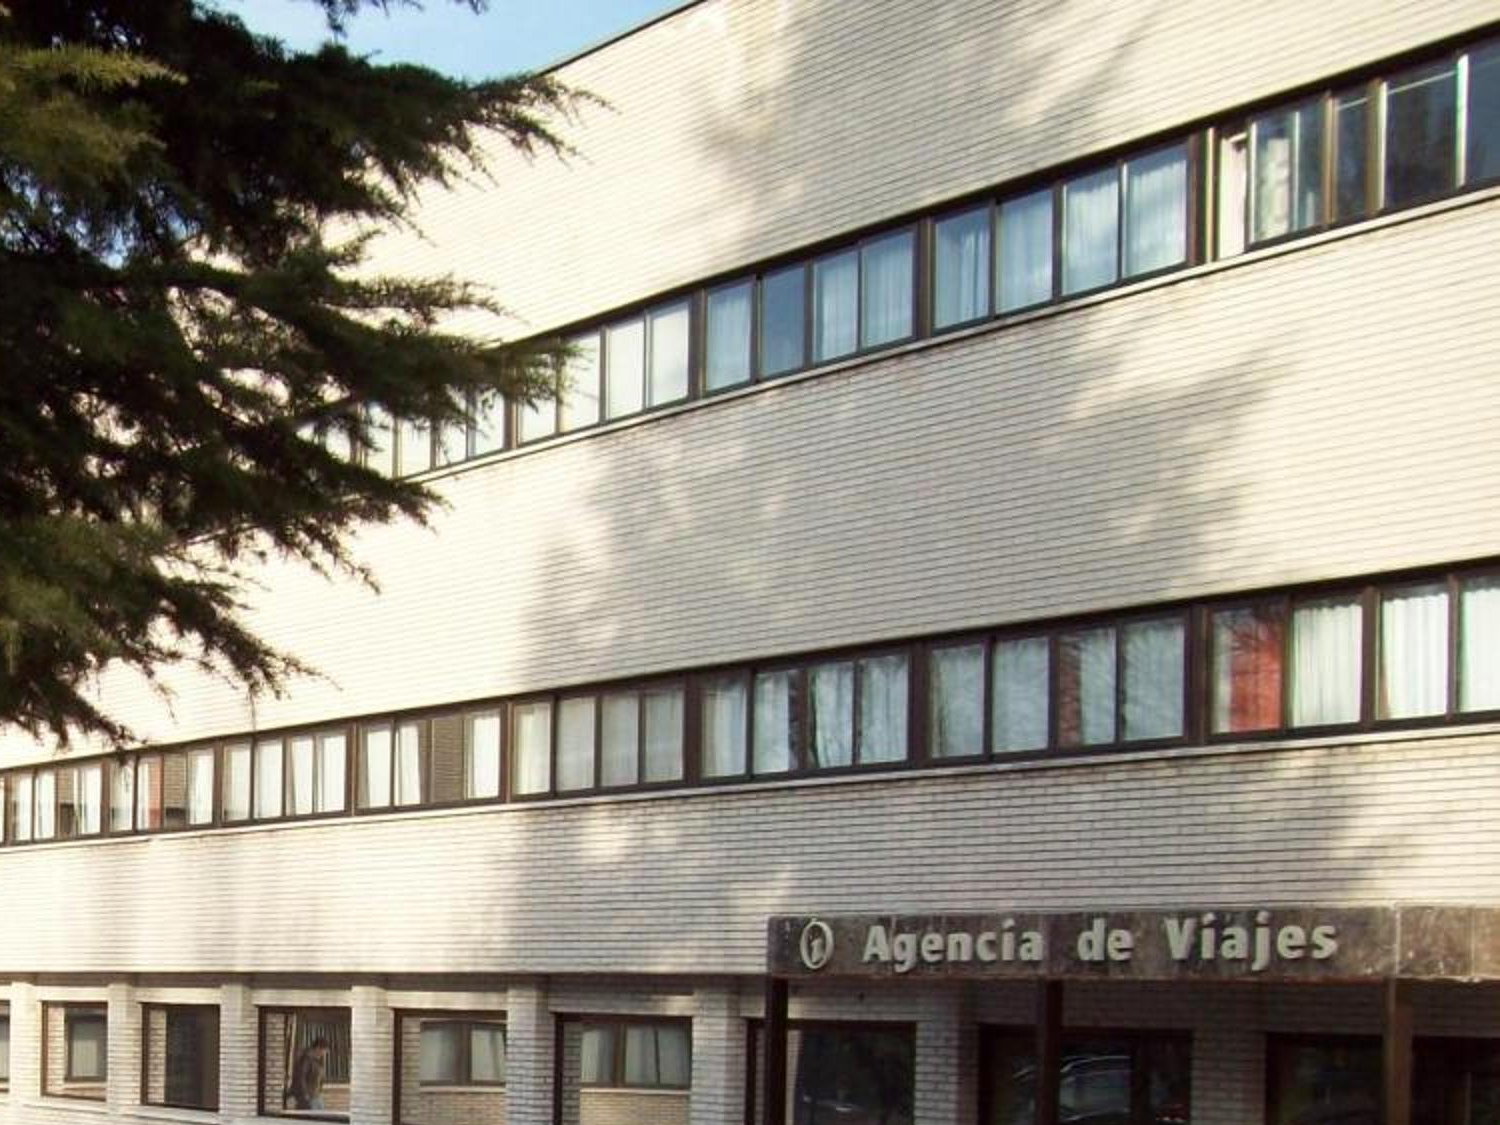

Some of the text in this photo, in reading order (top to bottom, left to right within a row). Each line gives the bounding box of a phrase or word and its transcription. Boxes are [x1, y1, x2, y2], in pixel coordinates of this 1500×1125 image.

[862, 911, 1339, 973] Agencia de Viajes
